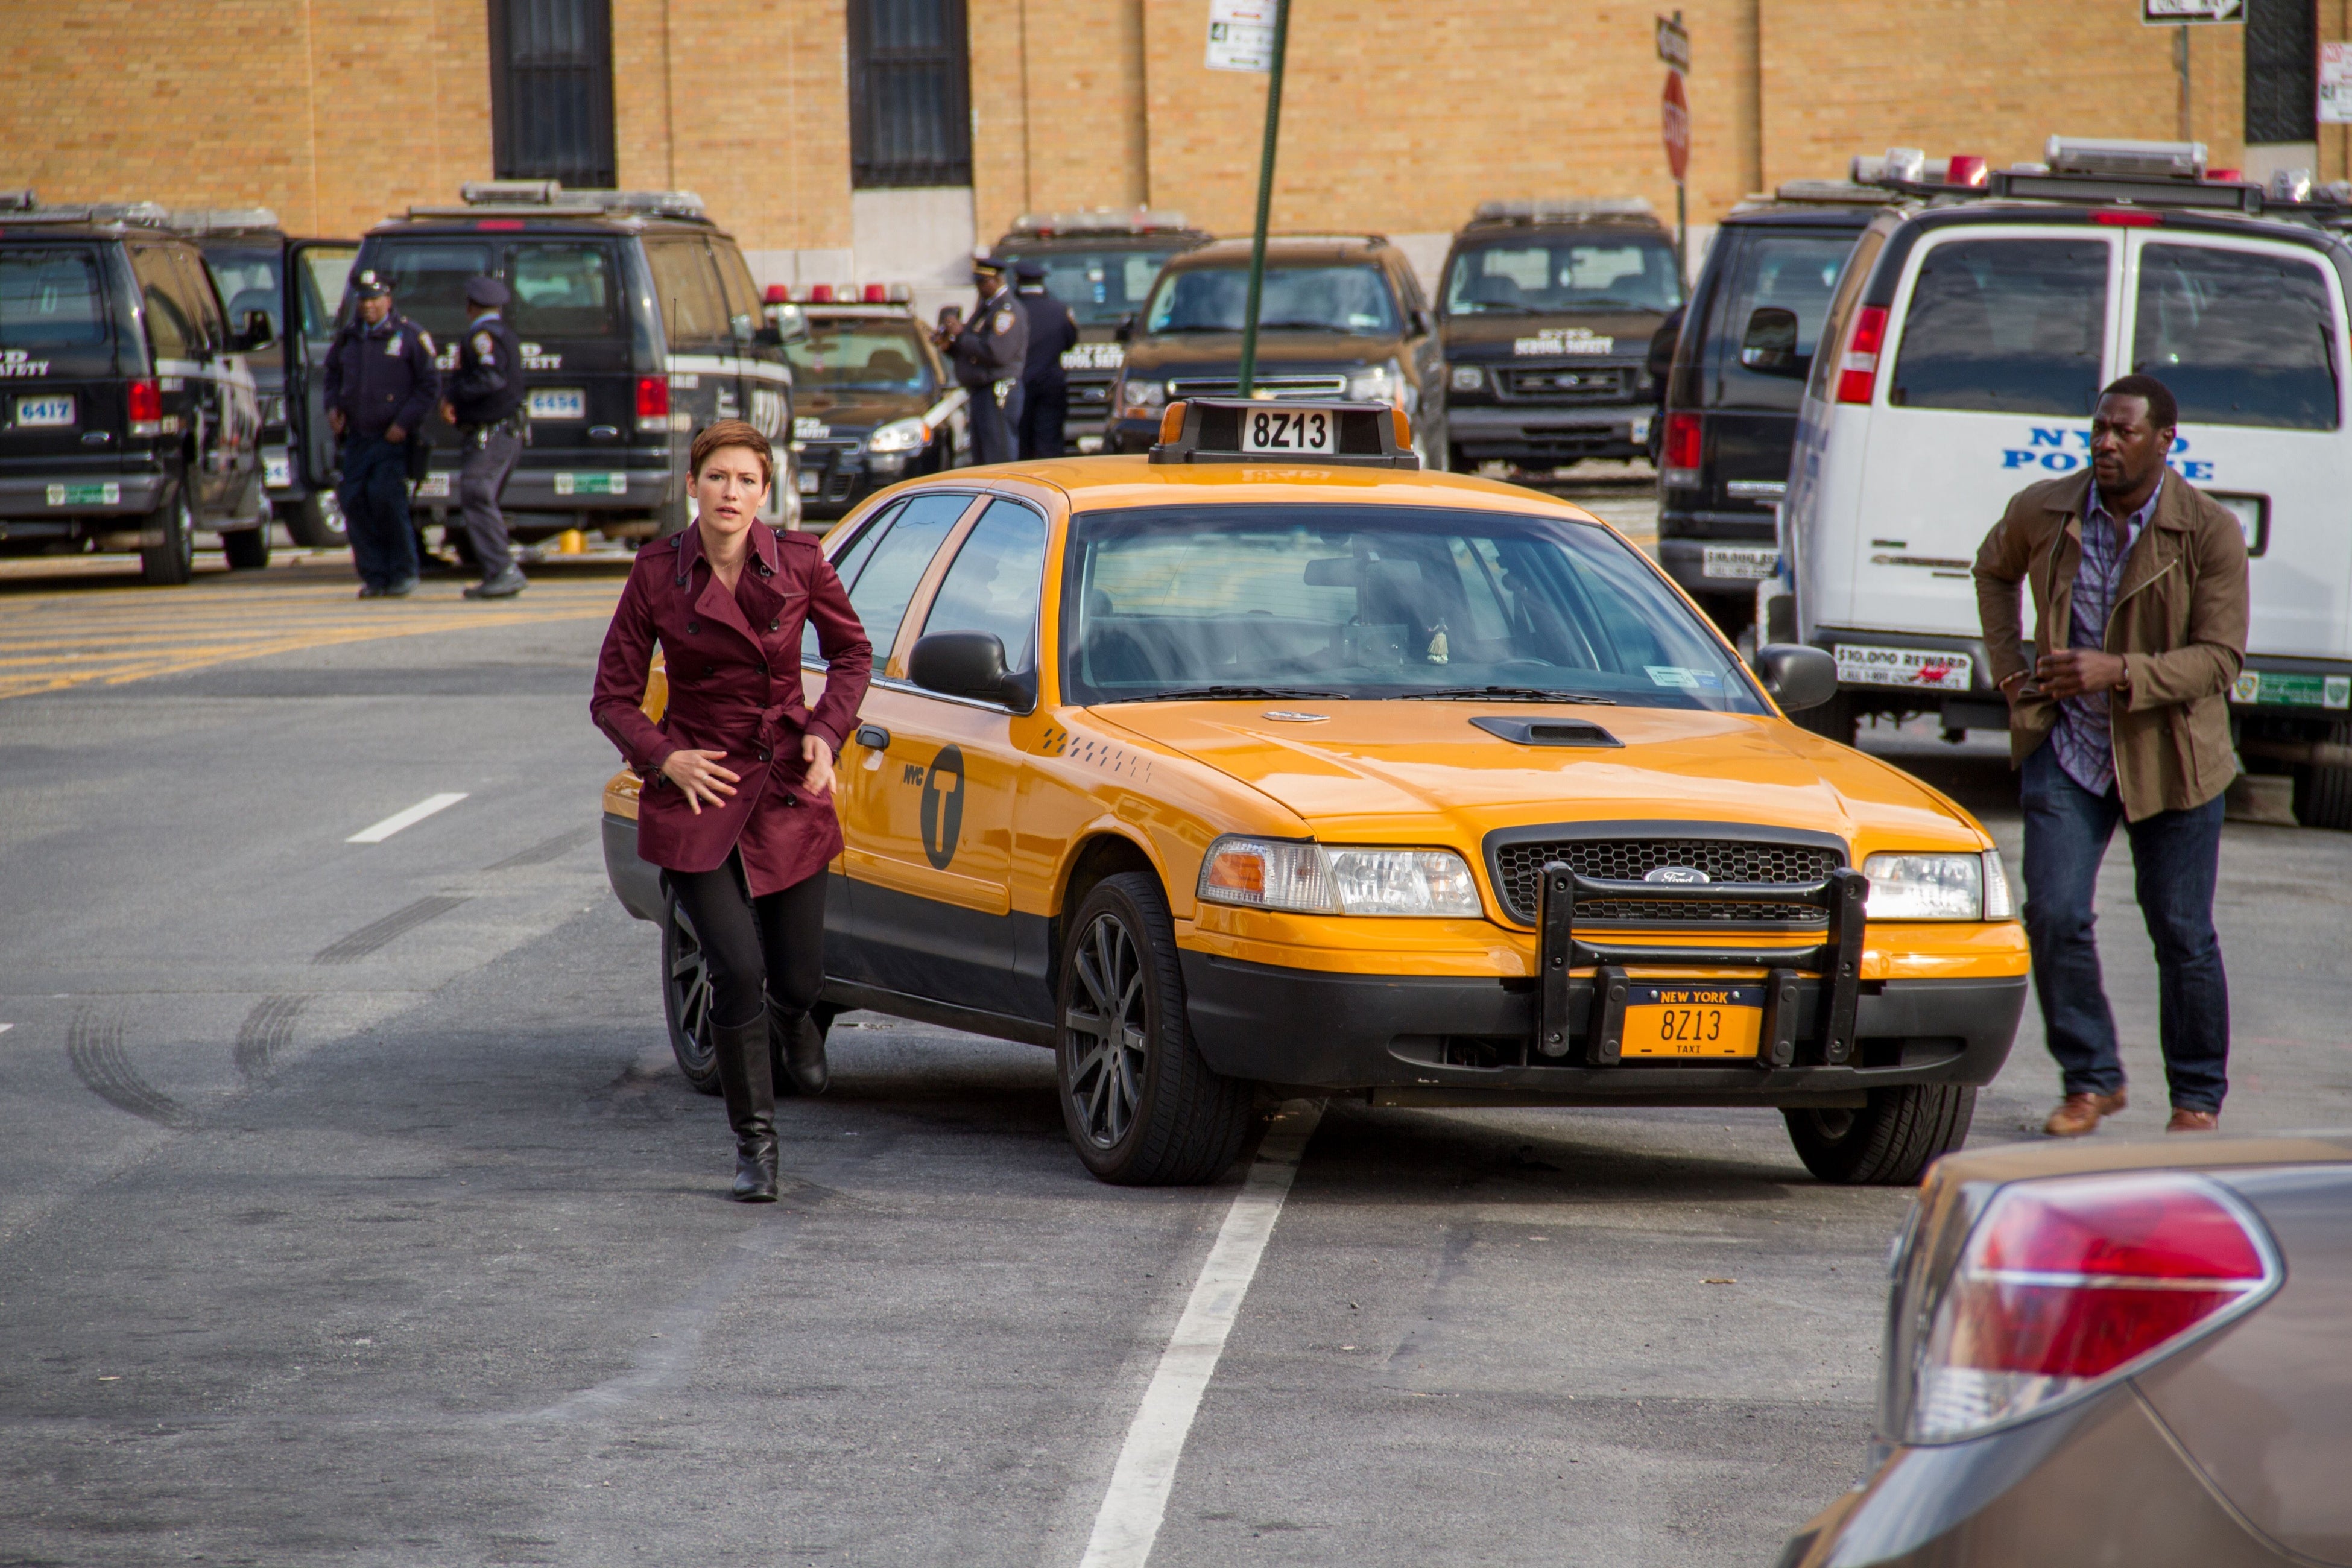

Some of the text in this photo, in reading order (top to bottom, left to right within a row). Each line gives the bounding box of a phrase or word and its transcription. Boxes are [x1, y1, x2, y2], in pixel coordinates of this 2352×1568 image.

[22, 402, 69, 419] 6417
[1254, 413, 1326, 448] 8Z13
[1905, 654, 1967, 668] REWARD
[903, 763, 925, 786] NYC
[933, 769, 958, 853] T
[1660, 991, 1728, 1004] NEW YORK
[1661, 1010, 1721, 1041] 8Z13
[1676, 1045, 1701, 1054] TAXI
